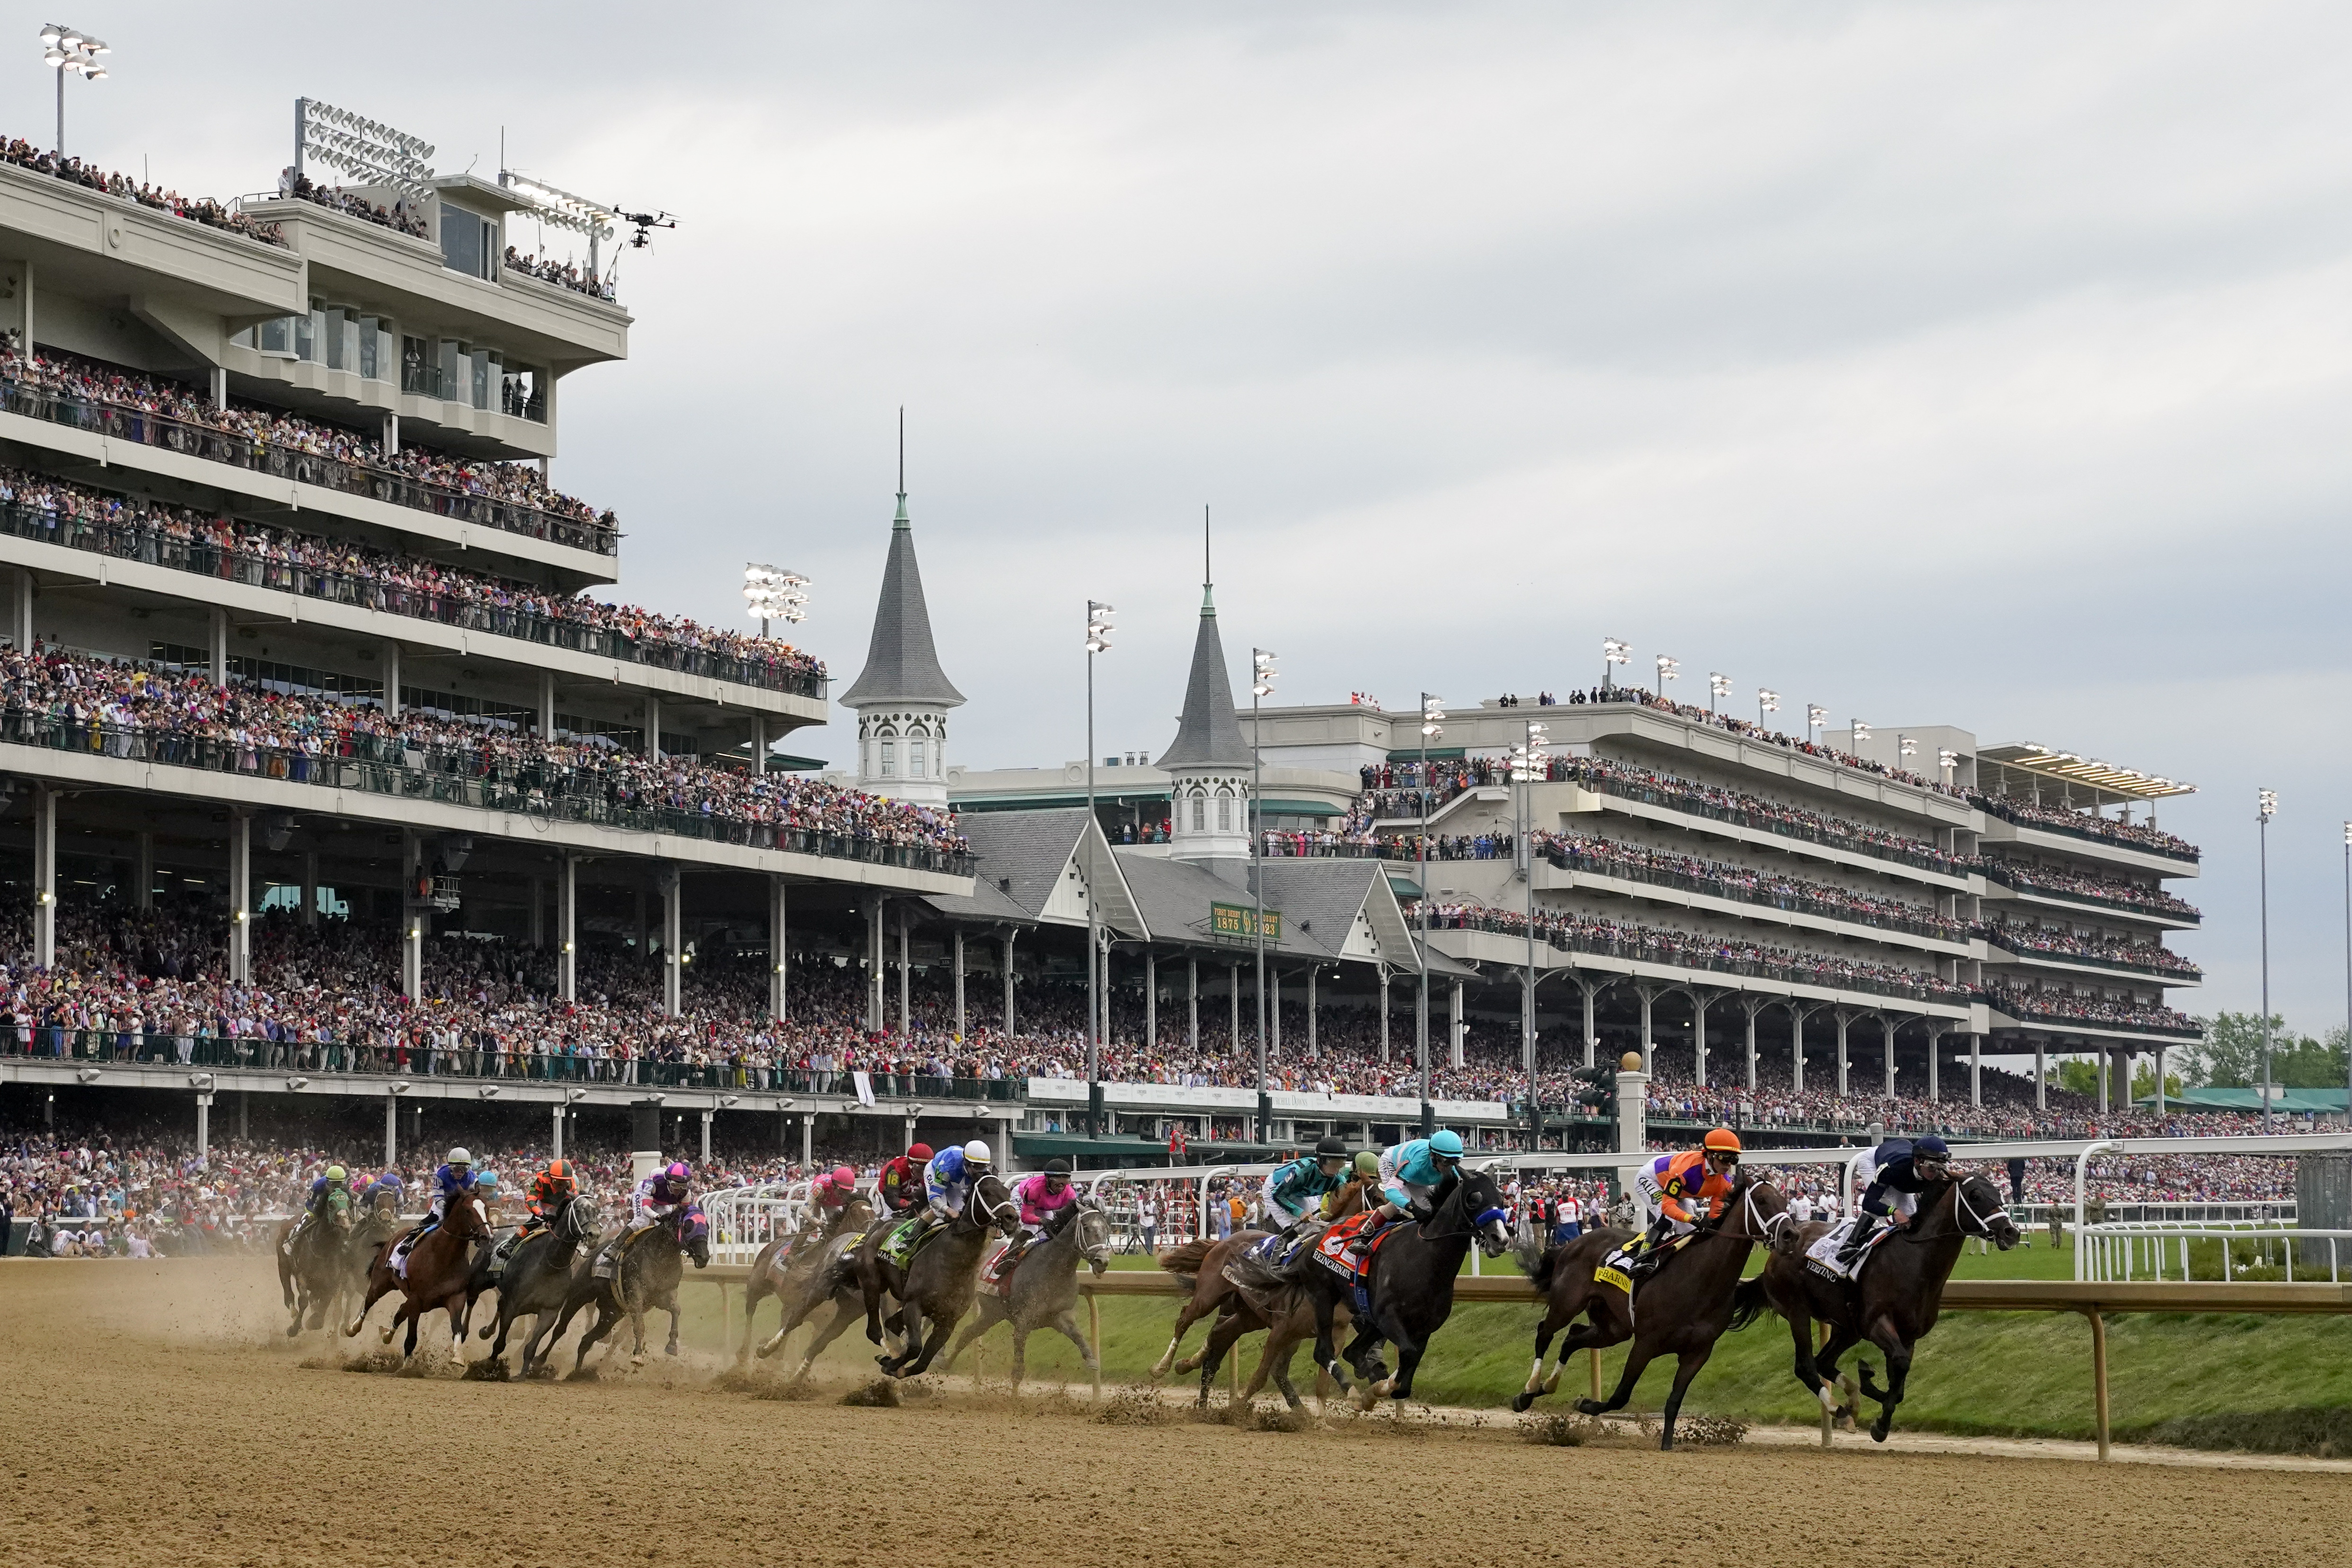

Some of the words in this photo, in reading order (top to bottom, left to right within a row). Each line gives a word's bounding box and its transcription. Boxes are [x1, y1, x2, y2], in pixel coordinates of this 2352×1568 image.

[1214, 908, 1226, 917] FIRST
[1227, 909, 1240, 918] DERBY
[1263, 915, 1278, 924] DERBY
[1217, 917, 1238, 931] 1875
[887, 1173, 899, 1186] 18
[1635, 1177, 1655, 1195] CALL
[642, 1183, 653, 1193] 22
[1669, 1181, 1681, 1195] 6
[1312, 1251, 1351, 1279] REINCARNATE
